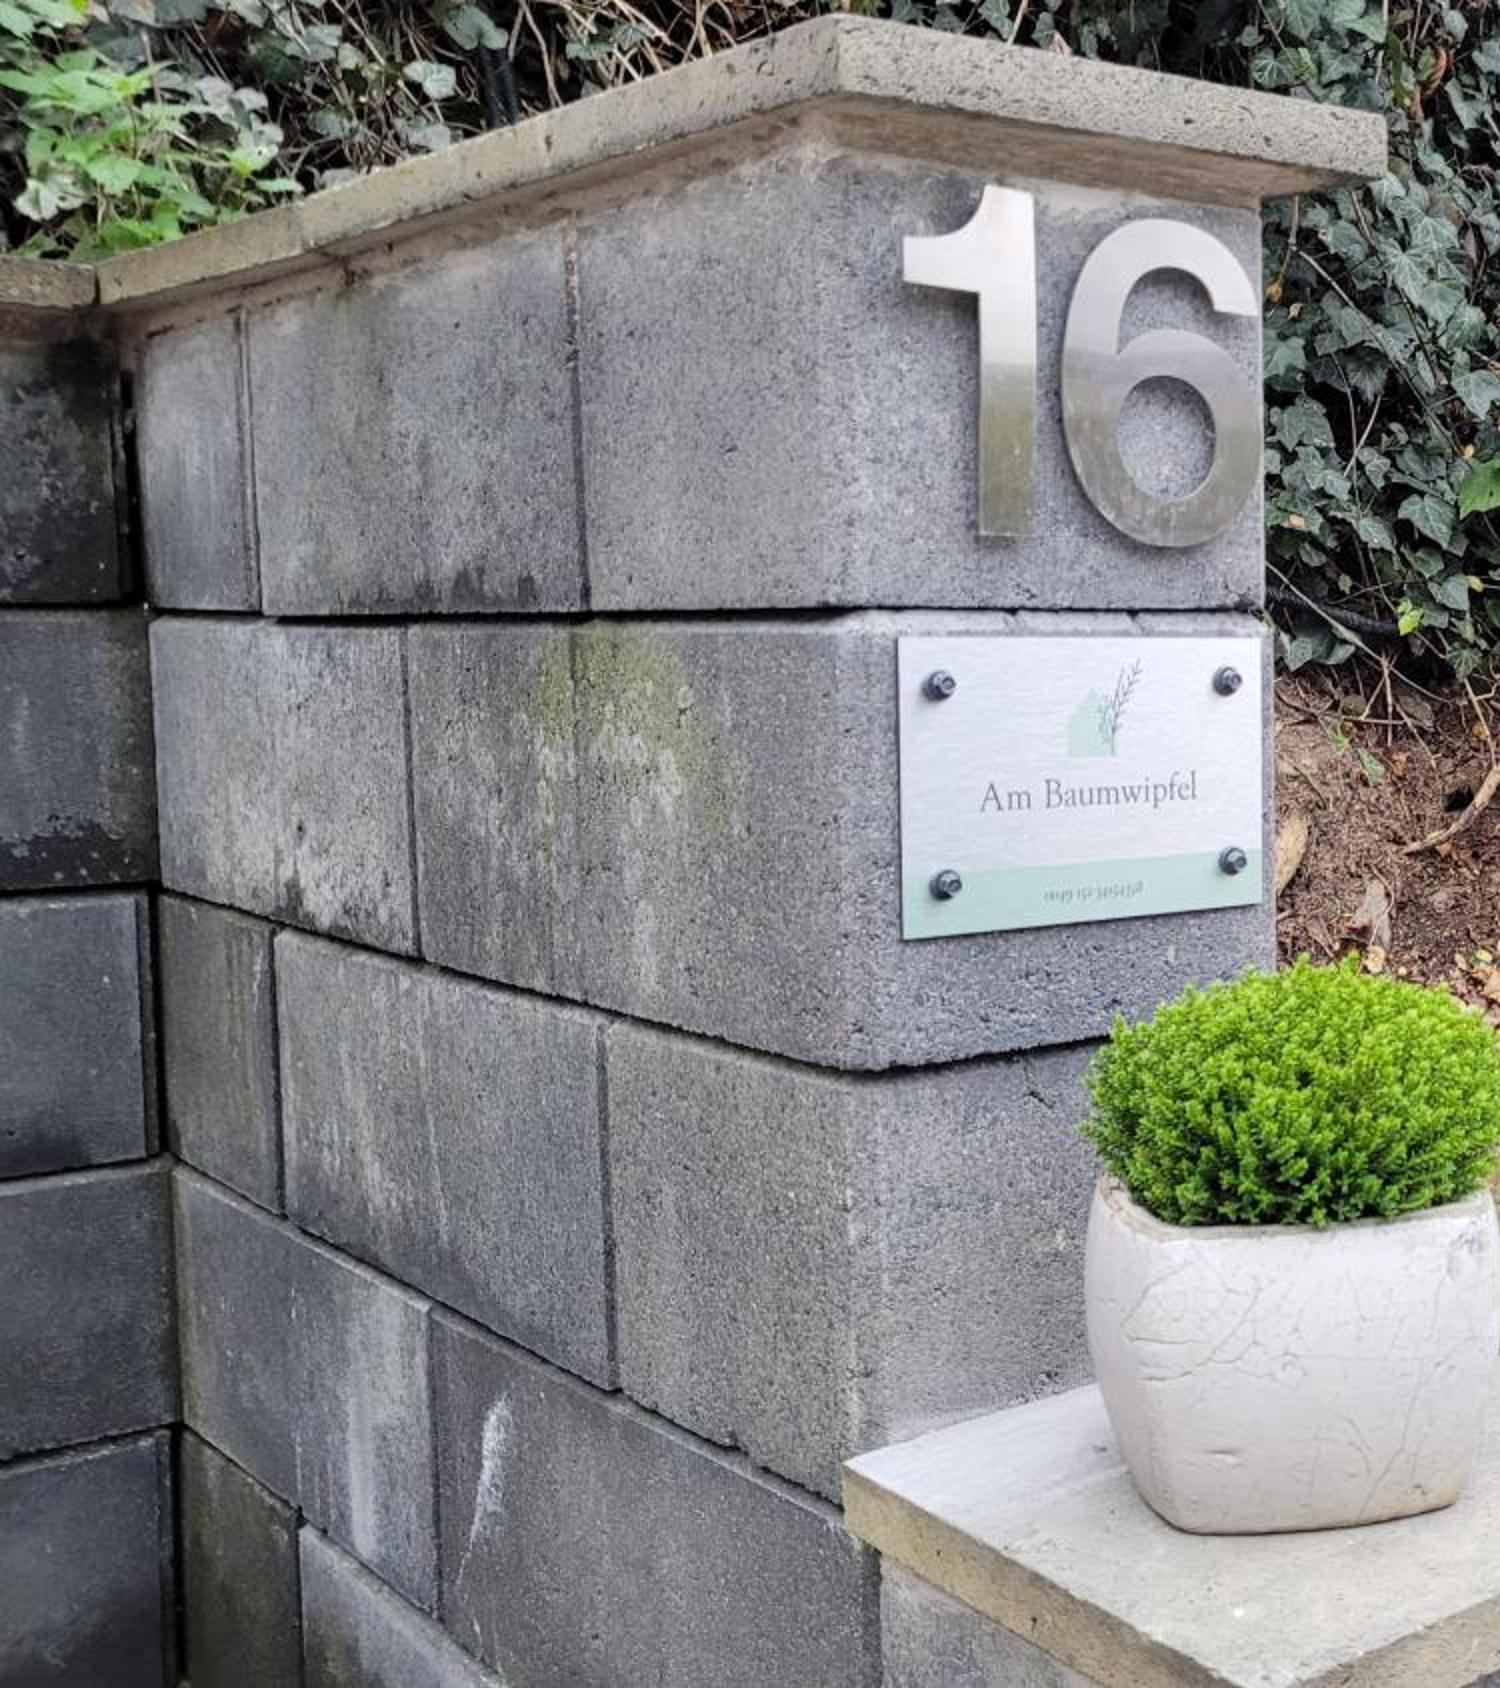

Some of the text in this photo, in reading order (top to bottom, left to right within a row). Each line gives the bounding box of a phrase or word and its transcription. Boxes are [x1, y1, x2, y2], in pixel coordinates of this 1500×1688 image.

[902, 184, 1263, 548] 16
[980, 770, 1198, 812] Am Baumwipfel
